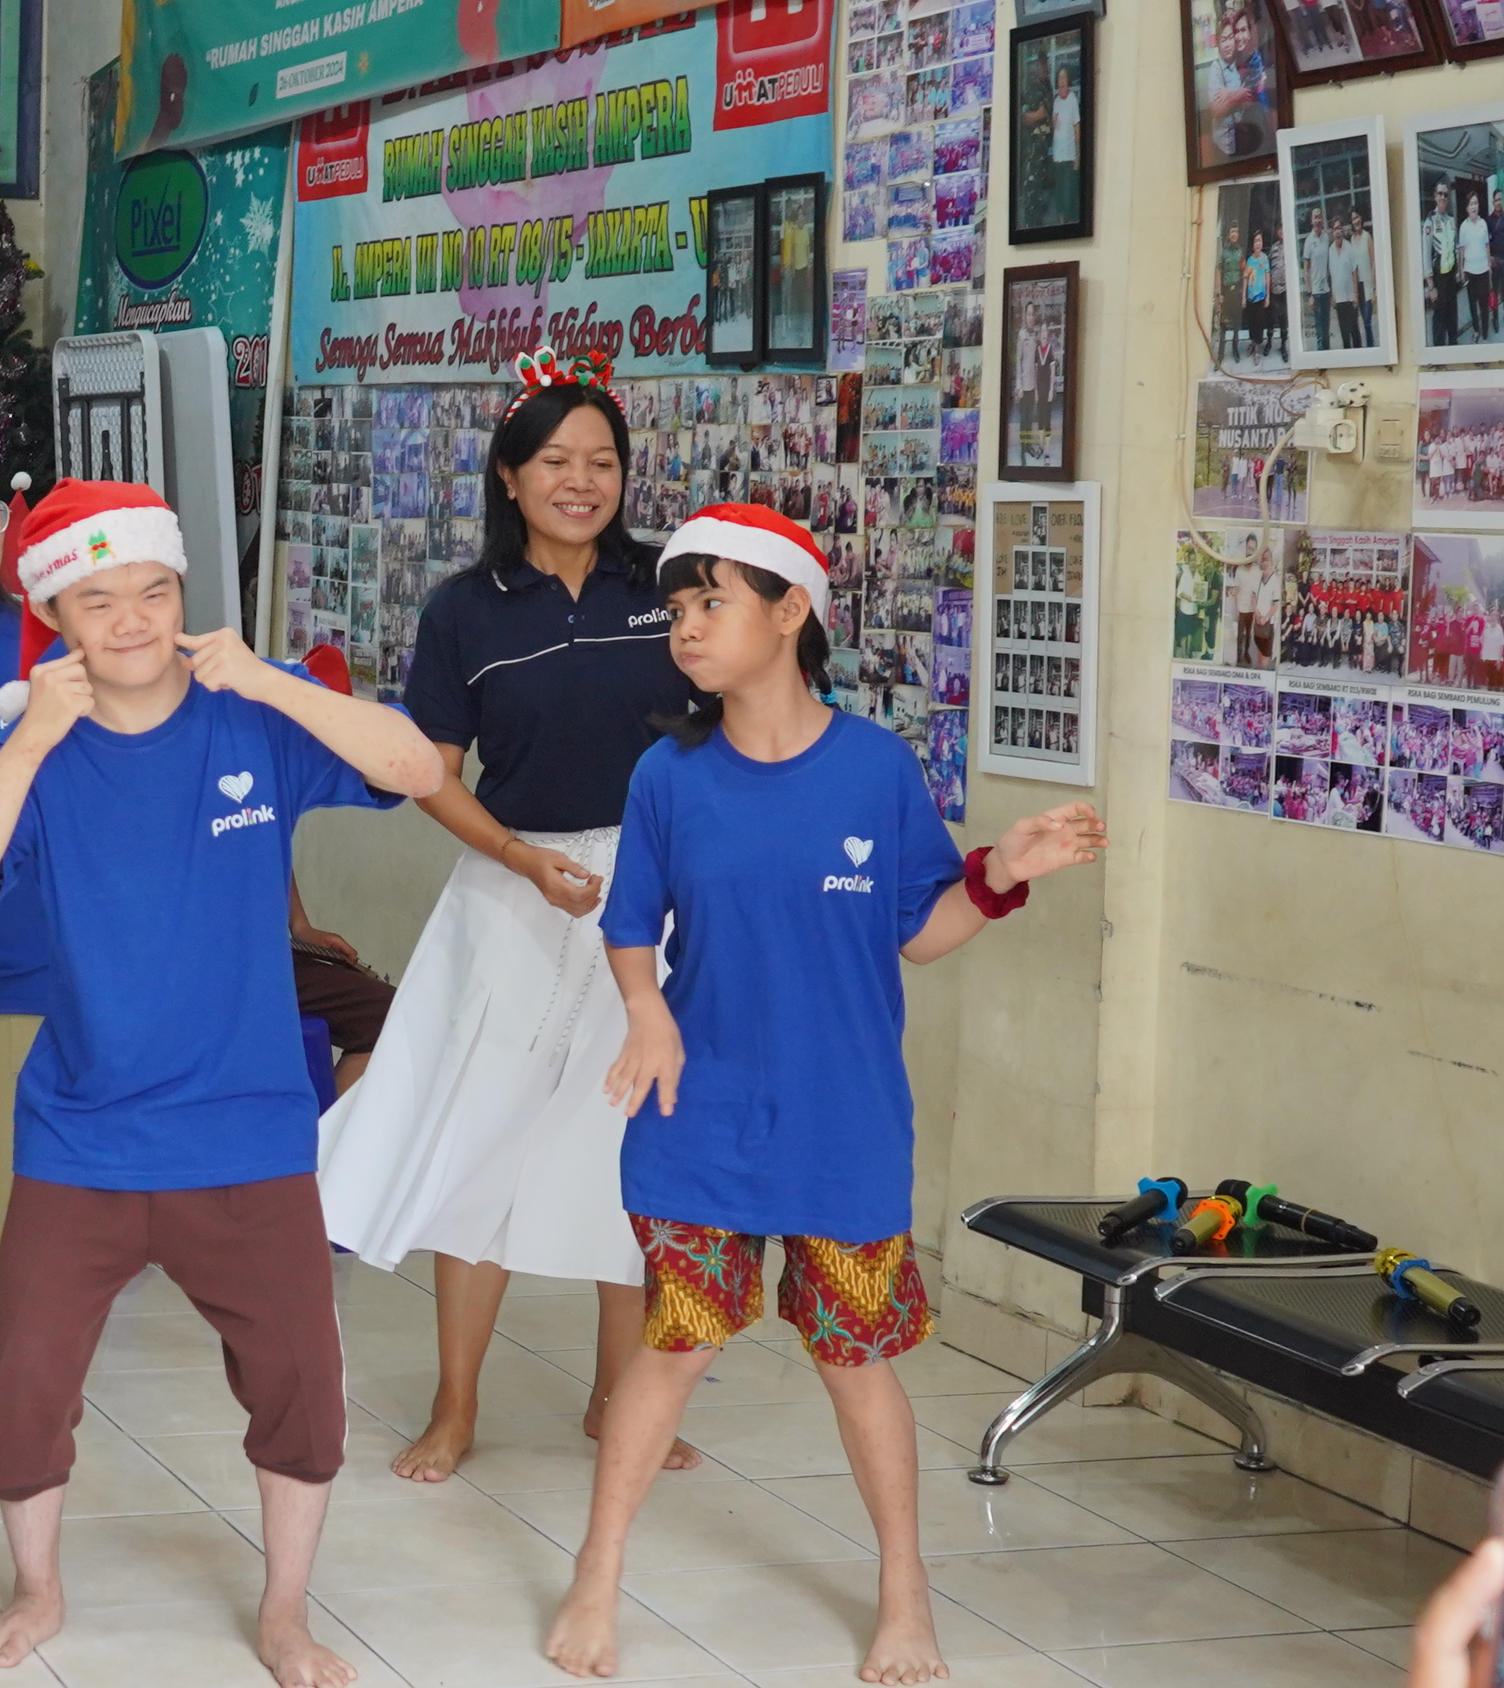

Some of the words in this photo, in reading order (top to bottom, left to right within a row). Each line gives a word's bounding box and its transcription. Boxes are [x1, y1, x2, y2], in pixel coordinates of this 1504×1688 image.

[260, 19, 320, 57] SINGGAH
[323, 3, 366, 38] KASIH
[382, 128, 444, 203] RUMAH
[445, 110, 528, 193] SINGGAH
[530, 96, 589, 176] KASIH
[593, 75, 691, 168] AMPERA
[130, 174, 183, 249] Pixel
[330, 244, 351, 302] JL.
[354, 235, 412, 300] AMPERA
[440, 228, 464, 292] NO
[468, 225, 486, 290] 10
[487, 222, 518, 288] RT
[585, 200, 675, 280] JAKARTA
[114, 286, 192, 334] Mengucapkan
[315, 327, 379, 383] Semoga
[379, 322, 446, 371] Semua
[548, 301, 624, 377] Hidup
[1227, 404, 1259, 426] TITIK
[628, 607, 672, 628] prolin
[211, 804, 276, 837] prolink
[823, 874, 875, 894] prolink
